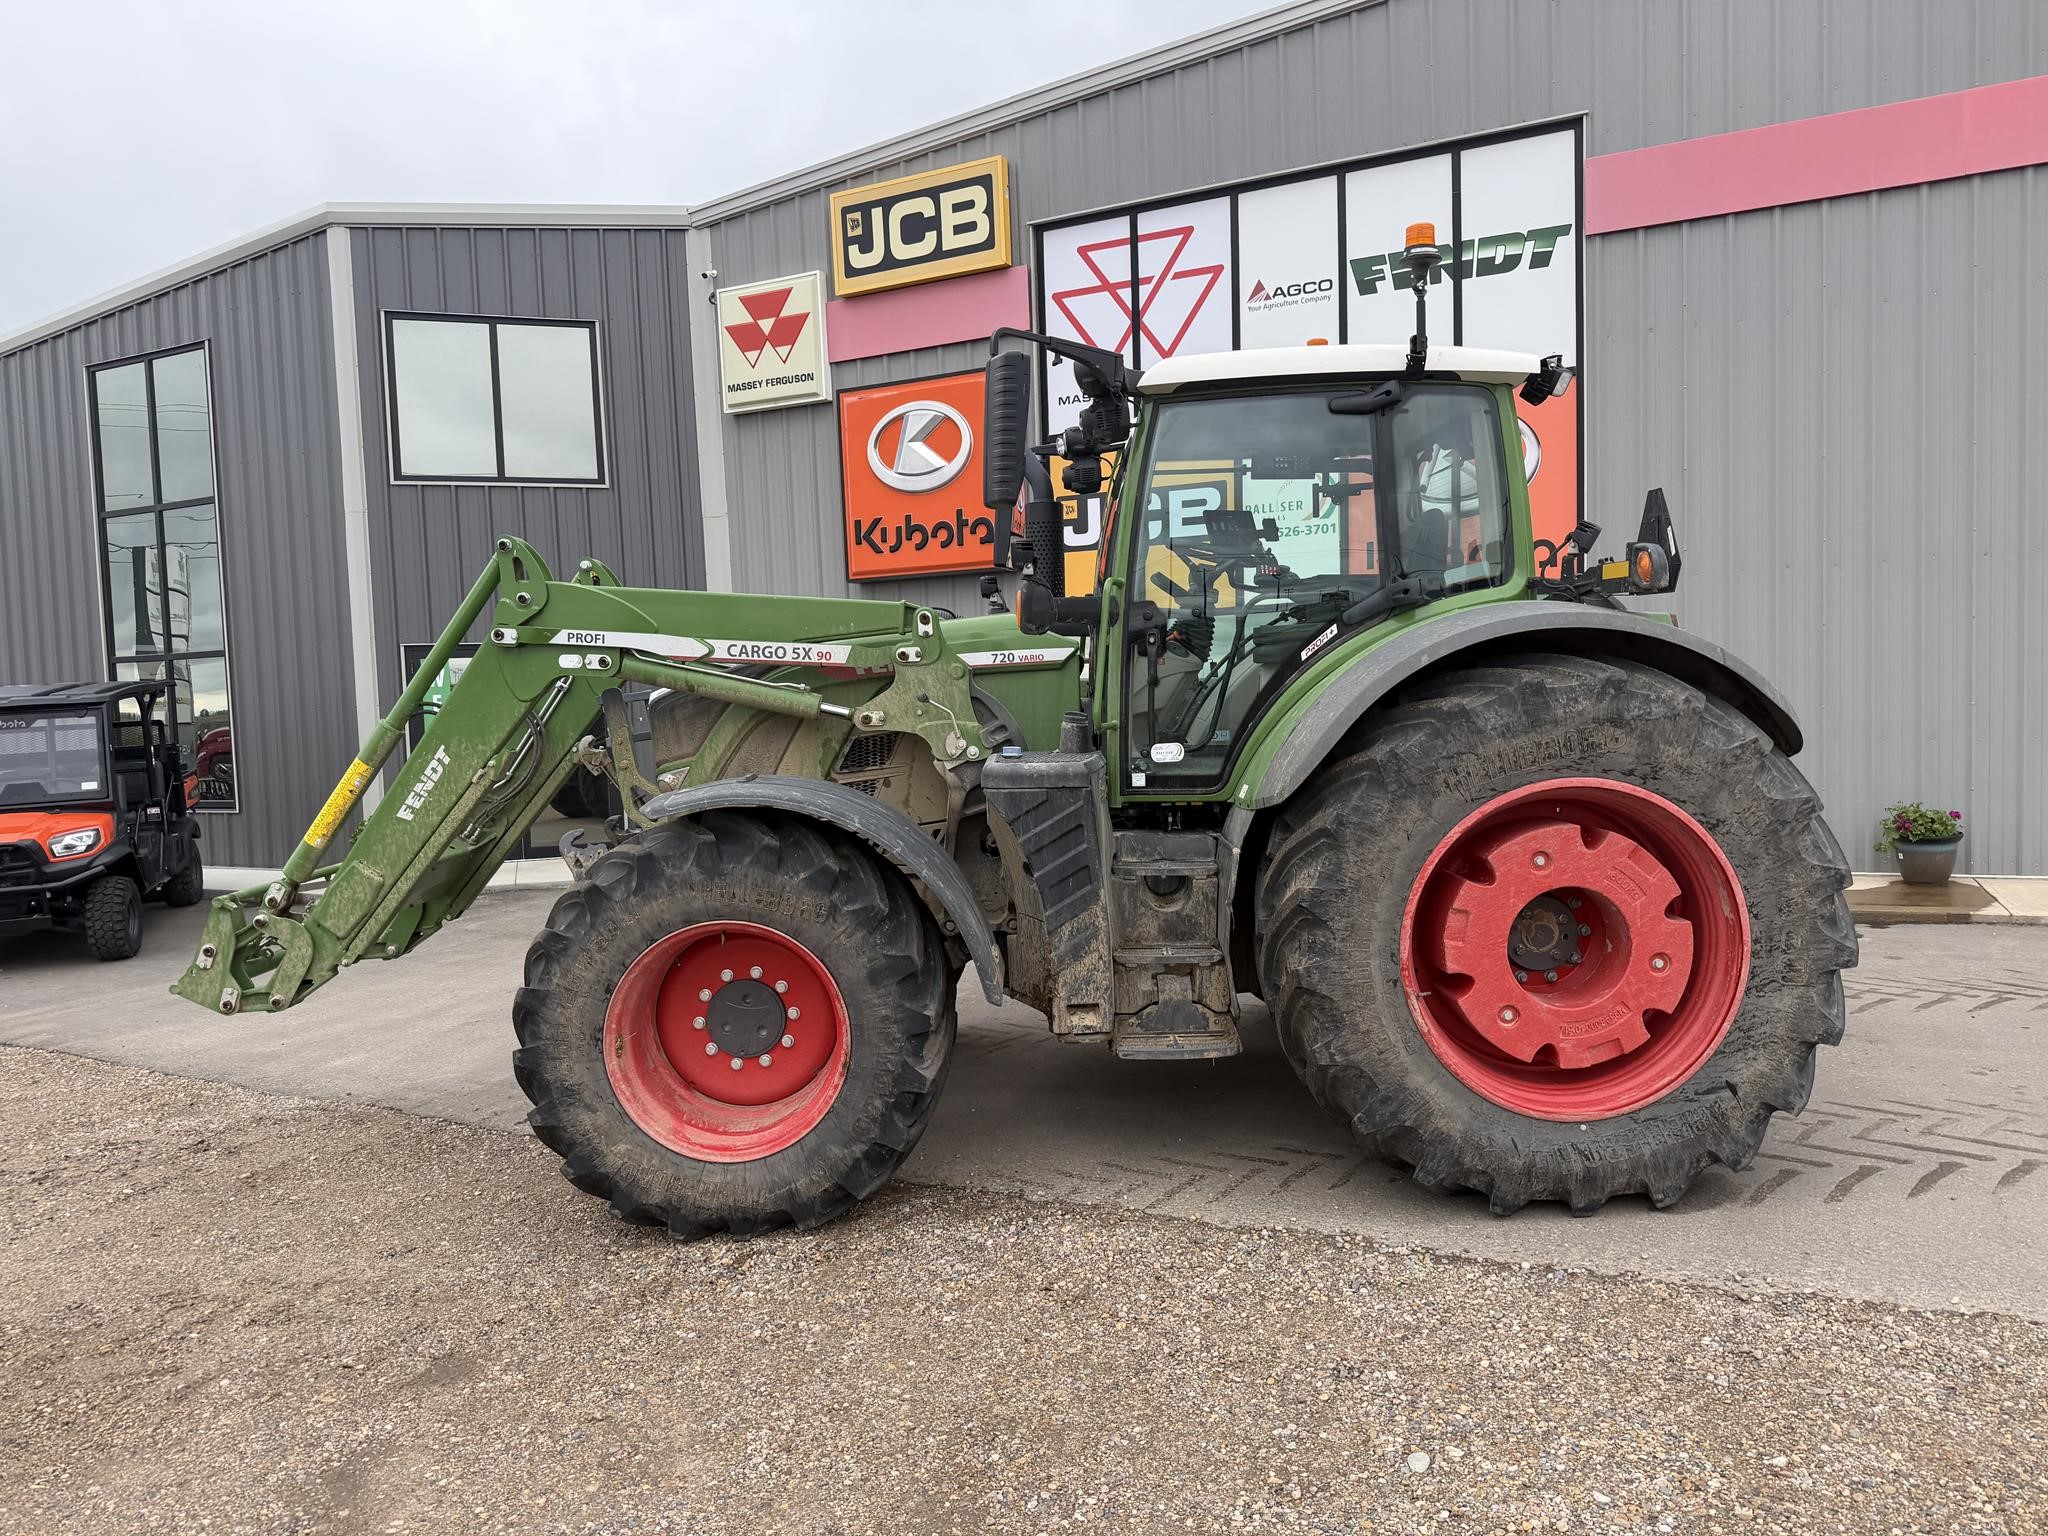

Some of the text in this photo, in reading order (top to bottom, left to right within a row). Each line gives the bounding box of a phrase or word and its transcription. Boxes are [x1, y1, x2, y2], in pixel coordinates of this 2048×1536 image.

[848, 185, 990, 269] JCB
[1272, 278, 1333, 299] AGCO
[1248, 294, 1332, 313] Your Agriculture Company
[727, 372, 815, 393] MASSEY FERGUSON
[1058, 394, 1092, 406] MAS
[854, 507, 995, 554] Kubota
[567, 632, 606, 645] PROFI
[1304, 632, 1329, 657] PROFI
[727, 643, 832, 662] CARGO 5X 90
[991, 652, 1045, 664] 720 VARIO
[0, 719, 26, 729] bota
[396, 744, 451, 821] FENDT
